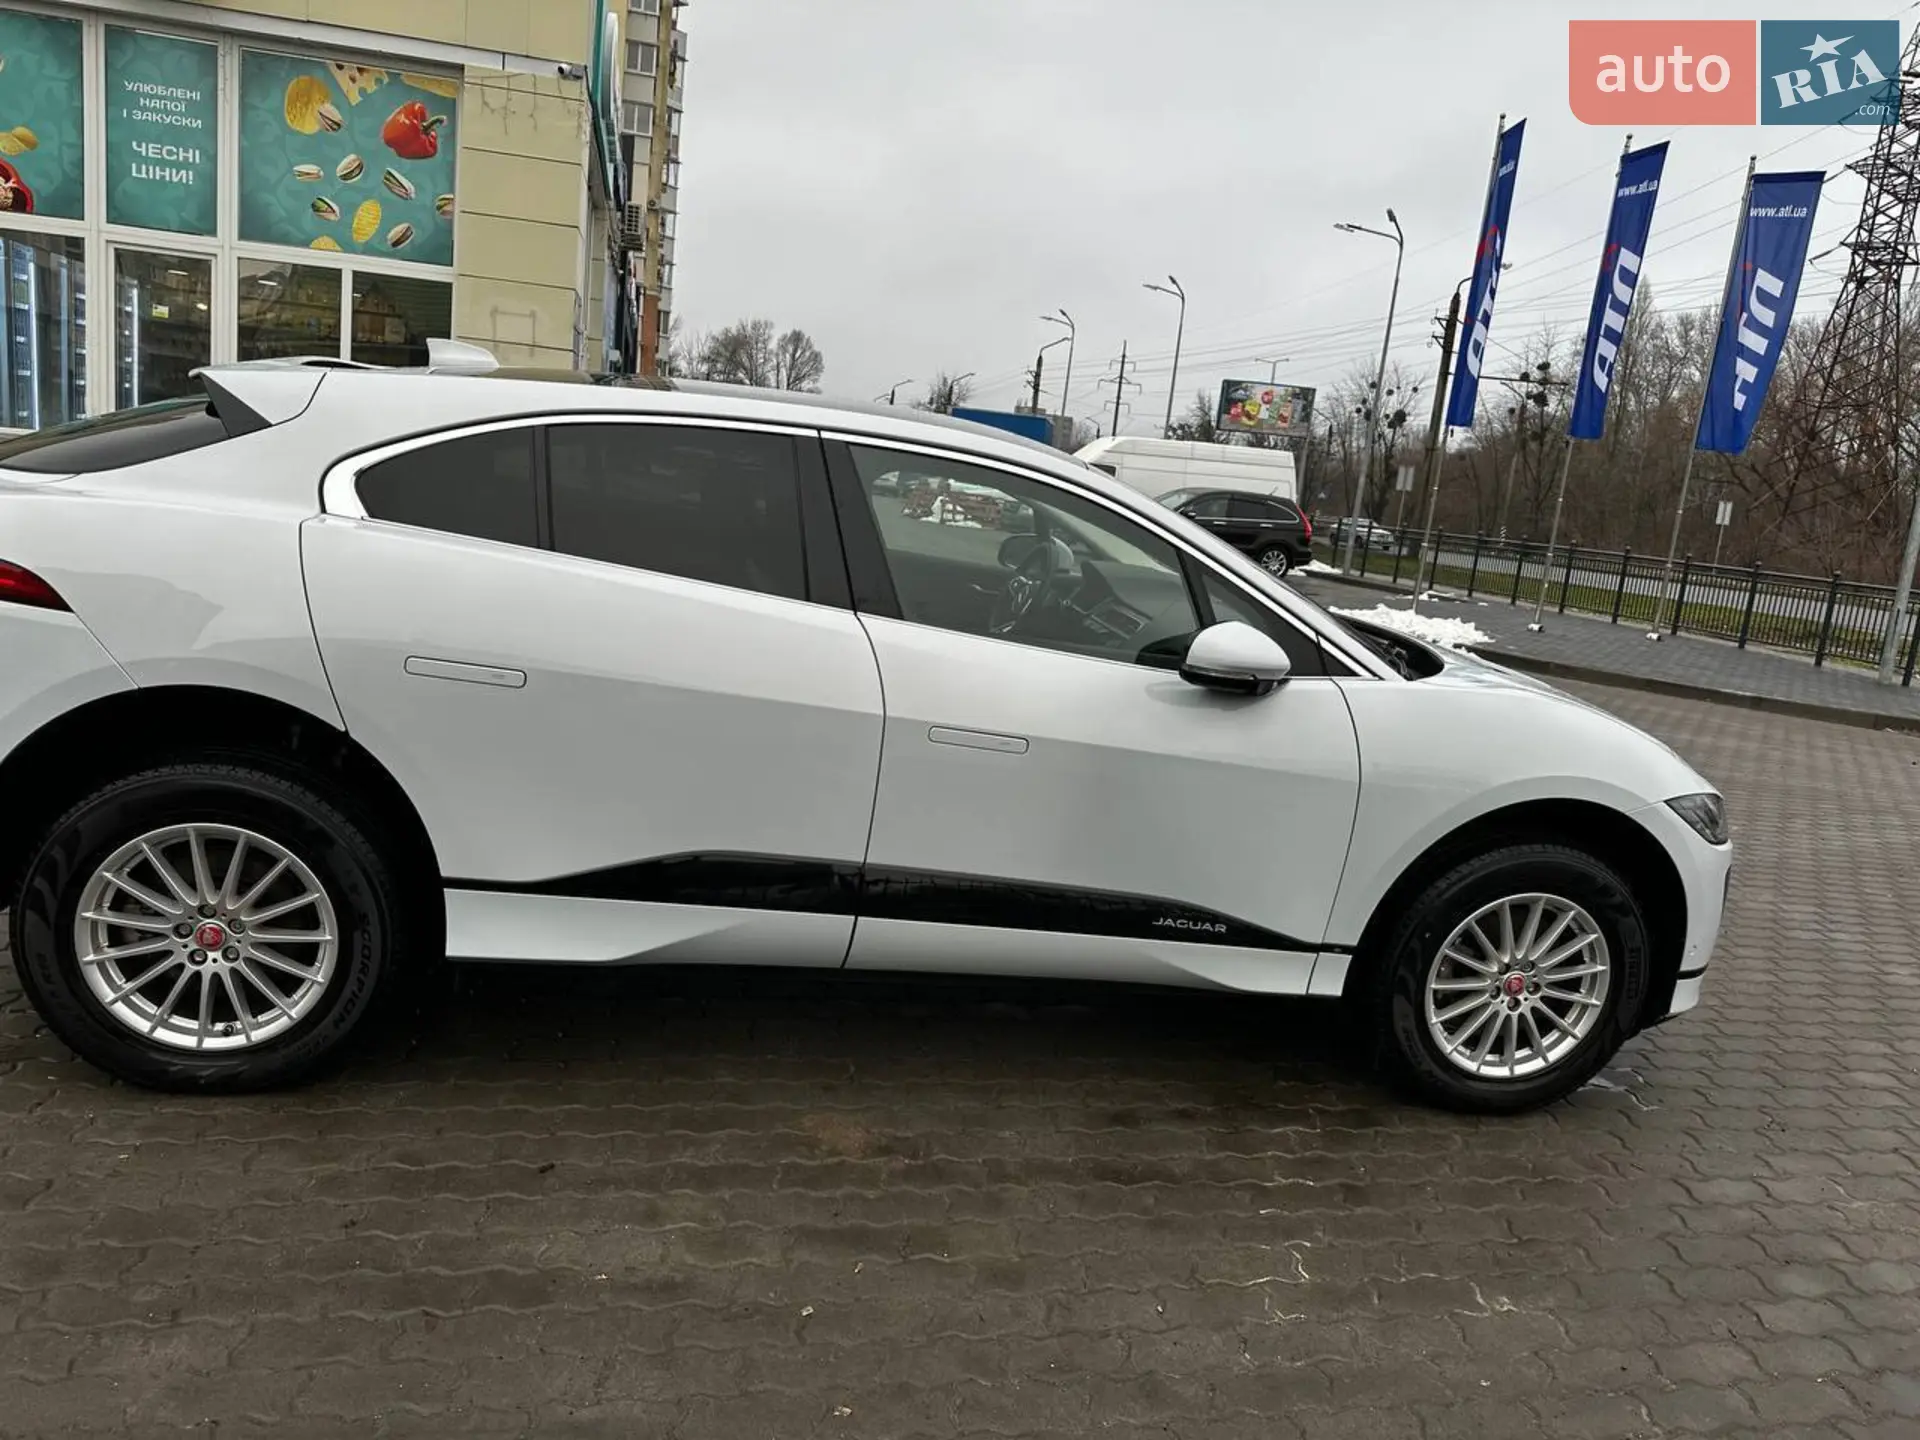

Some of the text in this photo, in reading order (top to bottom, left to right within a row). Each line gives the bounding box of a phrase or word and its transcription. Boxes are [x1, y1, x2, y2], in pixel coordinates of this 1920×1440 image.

[123, 80, 201, 101] УЛЮБЛЕНІ
[139, 97, 186, 112] НАПОЇ
[132, 109, 202, 129] ЗАКУСКИ
[131, 141, 200, 164] ЧЕСНІ
[131, 162, 193, 185] ЦІНИ!
[1749, 204, 1807, 218] www.atl.ua
[1151, 916, 1228, 934] JAGUAR
[333, 911, 373, 1030] SCORPION
